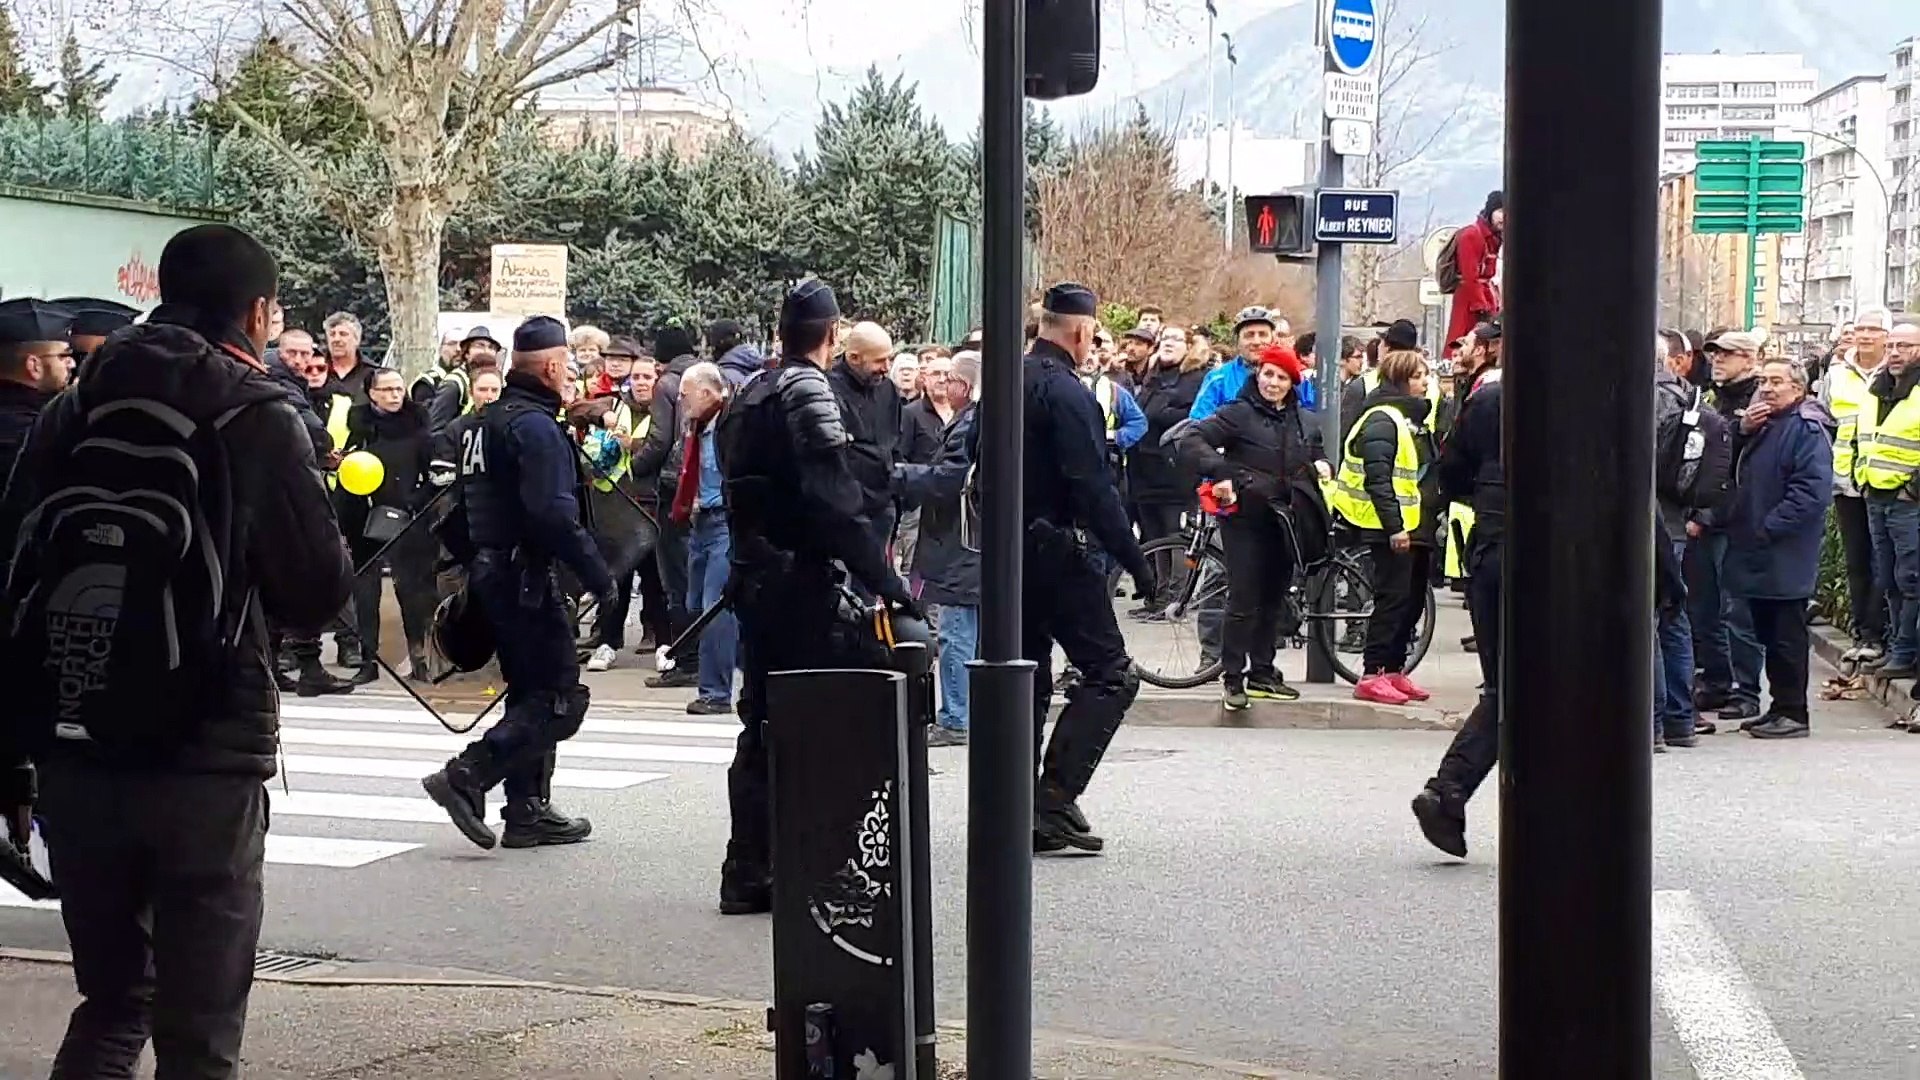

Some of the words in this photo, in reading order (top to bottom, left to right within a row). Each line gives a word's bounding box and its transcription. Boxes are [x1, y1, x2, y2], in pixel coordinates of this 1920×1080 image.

[1344, 199, 1369, 212] RUE
[1346, 217, 1393, 234] REYNIER
[43, 613, 67, 668] THE
[58, 614, 98, 719] NORTH
[84, 616, 117, 691] FACE
